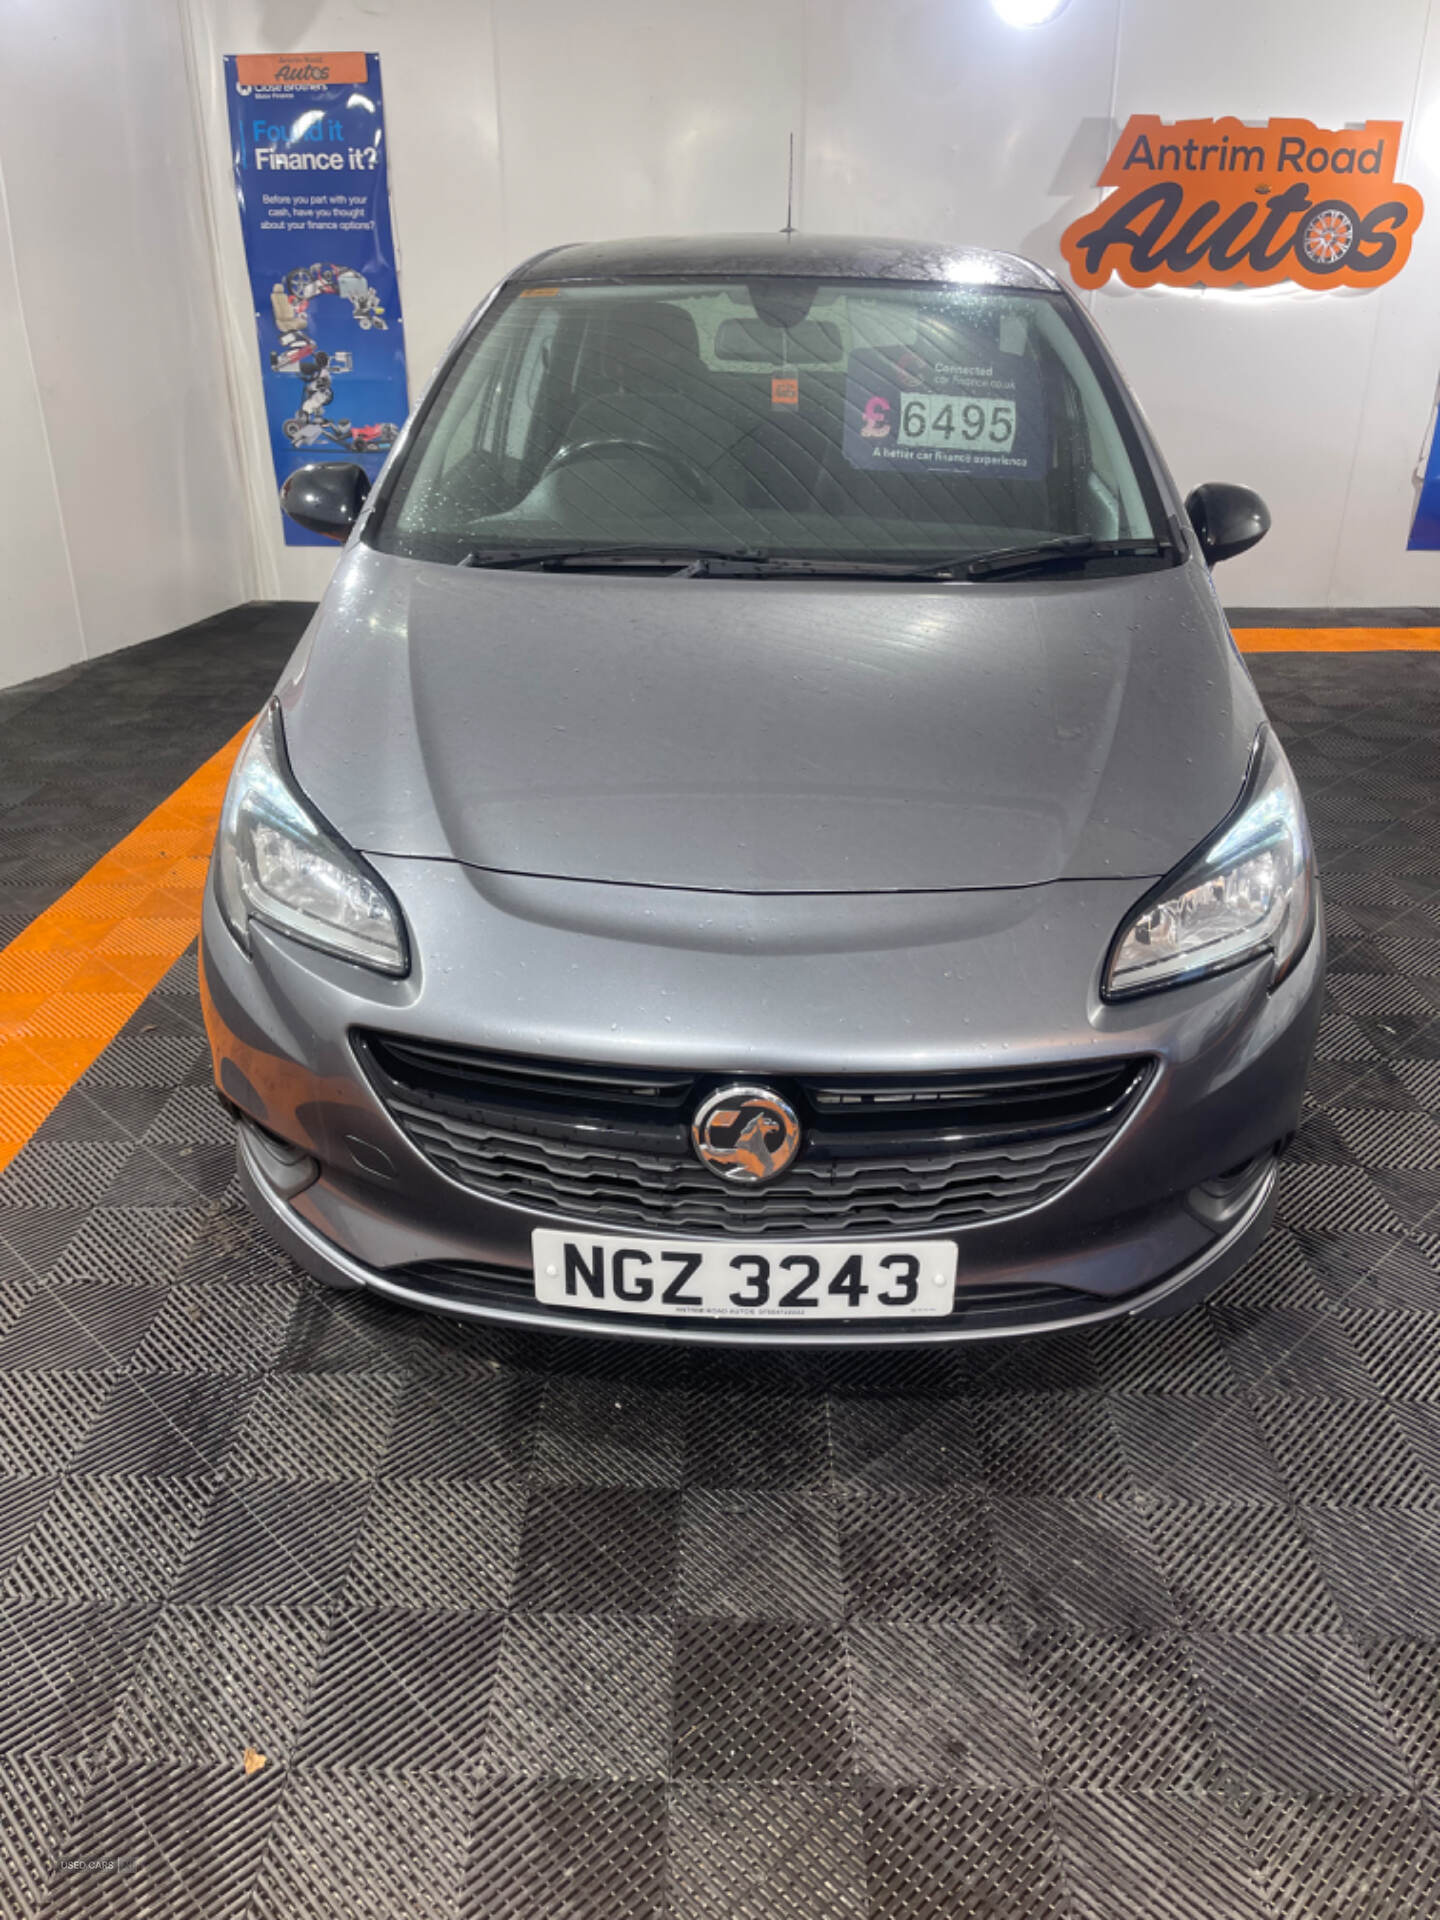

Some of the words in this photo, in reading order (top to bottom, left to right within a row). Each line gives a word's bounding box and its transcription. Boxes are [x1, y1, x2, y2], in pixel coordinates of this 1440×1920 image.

[274, 63, 329, 81] Autos
[328, 119, 345, 141] it
[254, 147, 344, 171] Finance
[348, 147, 376, 170] it?
[1123, 133, 1265, 173] Antrim
[1276, 136, 1385, 175] Road
[262, 194, 292, 205] Before
[293, 196, 309, 207] you
[310, 195, 327, 206] part
[329, 195, 347, 205] with
[348, 196, 367, 206] your
[268, 208, 291, 218] cash,
[293, 208, 314, 217] have
[315, 210, 332, 219] you
[333, 208, 365, 219] thought
[260, 221, 285, 230] about
[287, 223, 306, 232] your
[307, 220, 338, 230] finance
[339, 220, 376, 232] options?
[1075, 181, 1409, 276] Autos
[934, 361, 993, 377] Connected
[902, 401, 1014, 444] 6495
[872, 447, 881, 457] A
[883, 448, 914, 460] better
[916, 451, 932, 462] car
[934, 451, 971, 463] finance
[973, 454, 1028, 468] experience
[563, 1242, 704, 1307] NGZ
[728, 1253, 921, 1308] 3243
